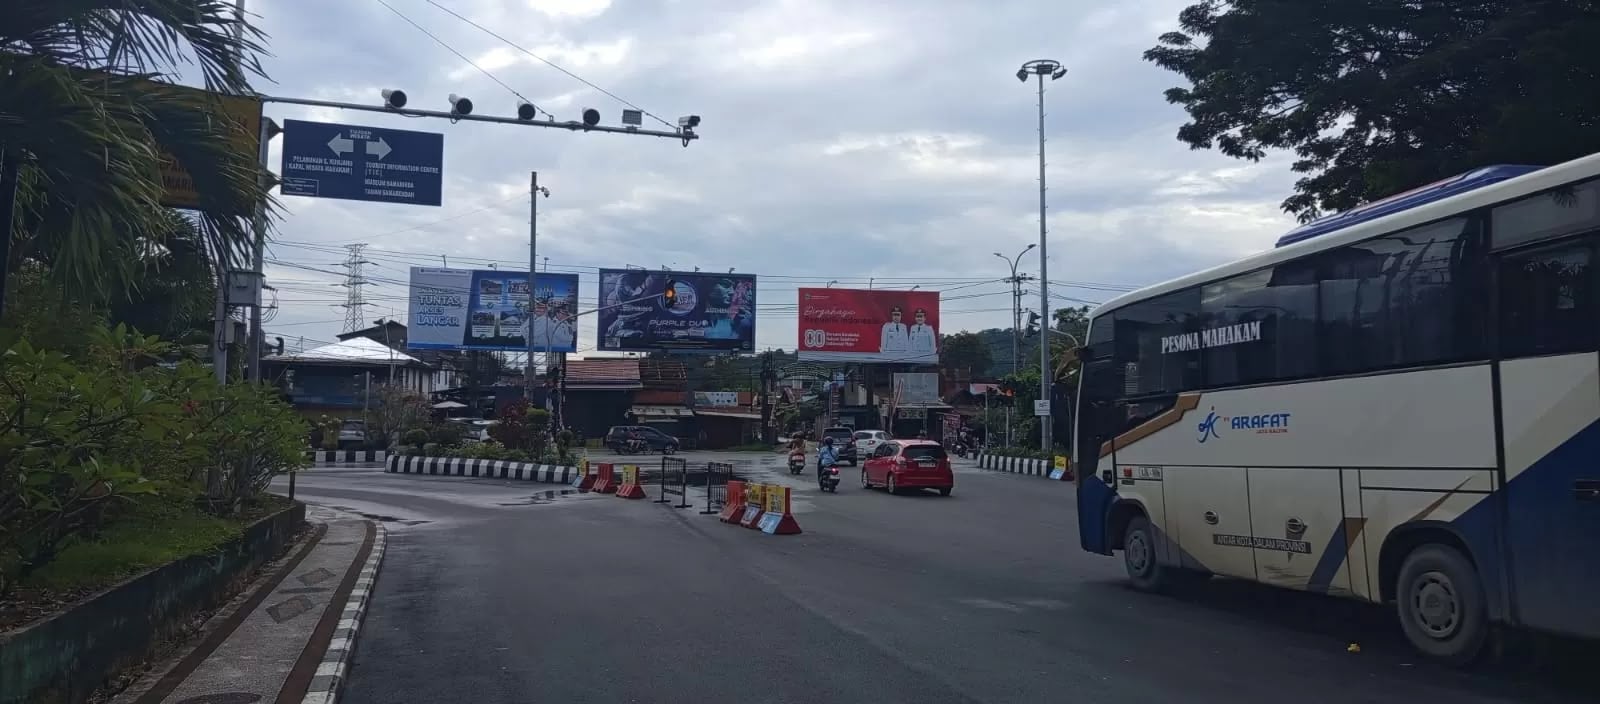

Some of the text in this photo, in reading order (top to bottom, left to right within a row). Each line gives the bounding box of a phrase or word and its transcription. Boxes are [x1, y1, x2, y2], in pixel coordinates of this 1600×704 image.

[366, 161, 386, 170] TOURIST
[387, 163, 419, 172] INFORMATION
[364, 178, 386, 187] MUSEUM
[417, 306, 445, 315] AKSES
[649, 319, 687, 327] PURPLE
[804, 329, 826, 348] 80
[1161, 320, 1261, 354] PESONA MAHAKAM
[1231, 413, 1291, 430] ARAFAT
[1217, 535, 1306, 552] ANTAR KOTA DALAM PROVINSI
